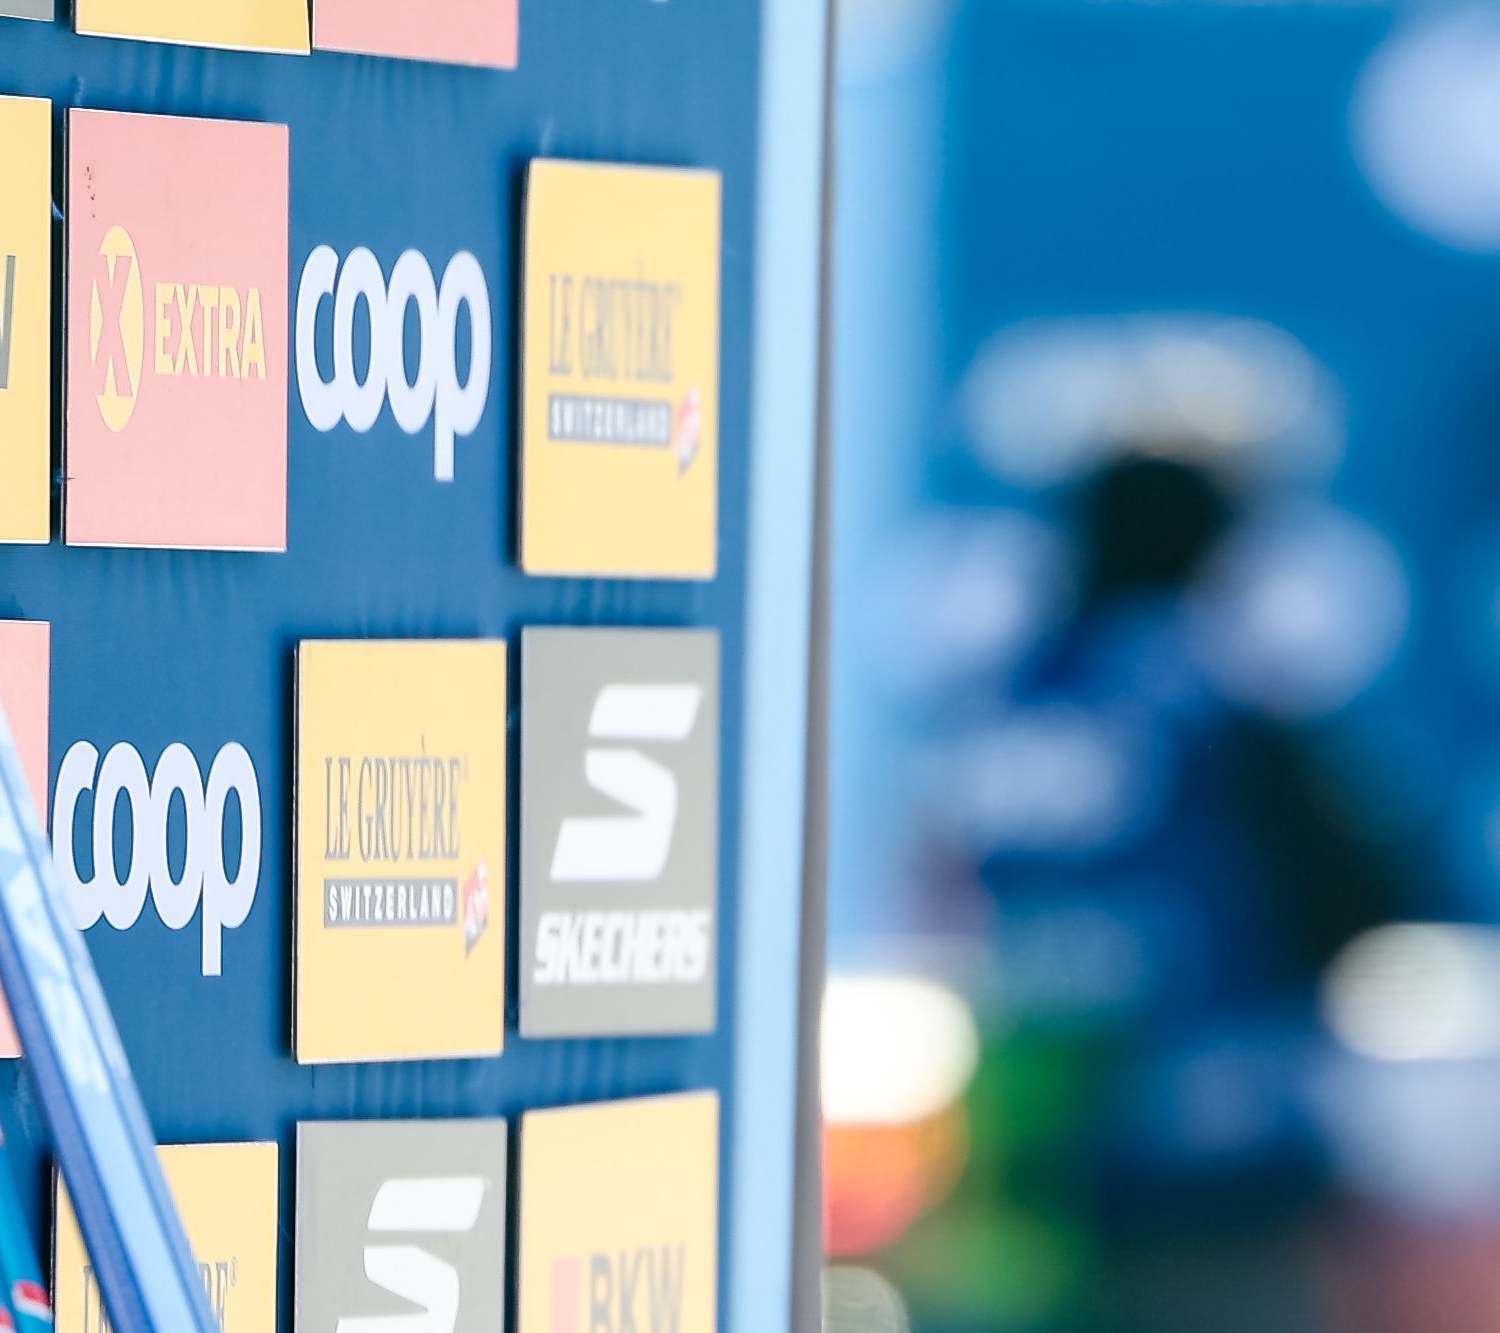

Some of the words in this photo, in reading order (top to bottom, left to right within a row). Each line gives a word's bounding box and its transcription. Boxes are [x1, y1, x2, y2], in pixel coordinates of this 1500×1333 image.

[155, 282, 267, 380] EXTRA
[296, 244, 492, 482] coop
[323, 756, 351, 860] LE
[358, 733, 461, 861] GRUYÈRE
[51, 740, 261, 978] coop
[327, 882, 454, 922] SWITZERLAND
[534, 911, 709, 986] SKECHERS
